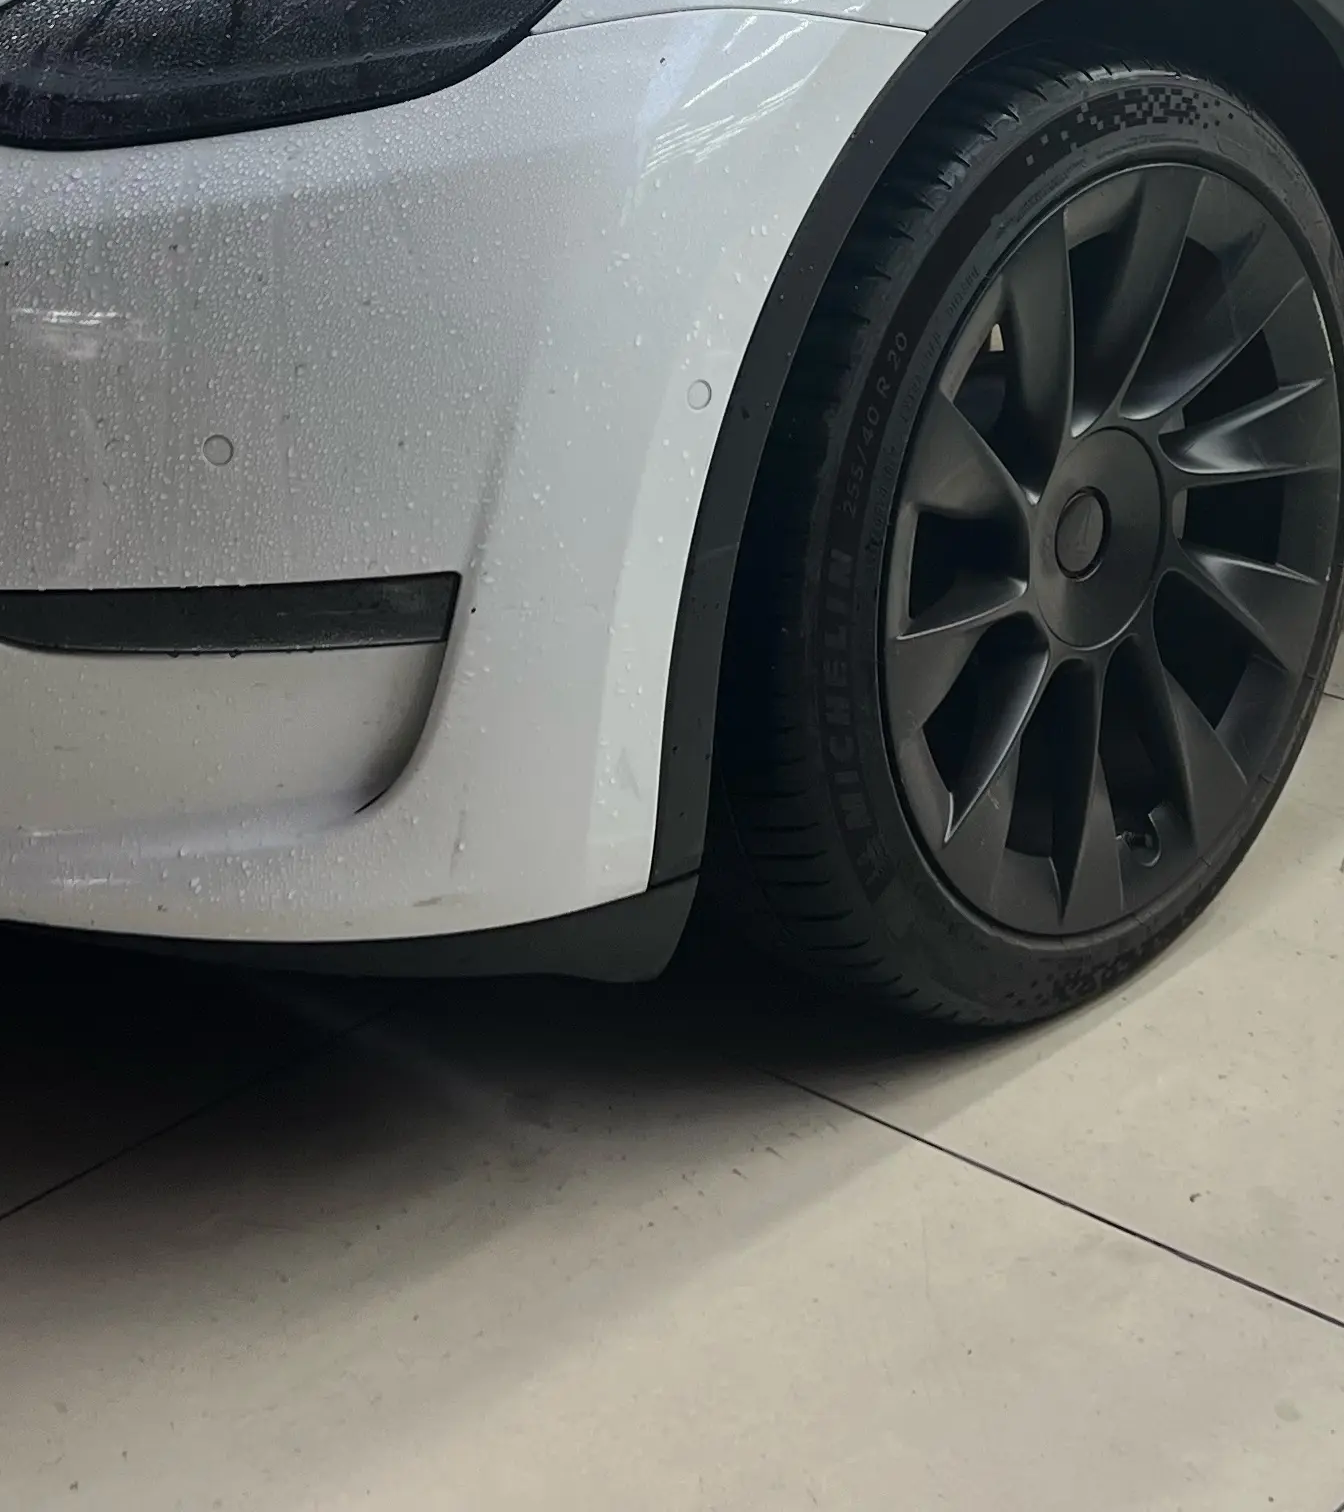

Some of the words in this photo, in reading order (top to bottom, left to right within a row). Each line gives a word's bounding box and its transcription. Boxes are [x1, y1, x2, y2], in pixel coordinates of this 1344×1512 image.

[843, 402, 882, 519] 255/40
[877, 374, 895, 401] R
[887, 329, 910, 374] 20
[824, 548, 867, 829] MICHELIN
